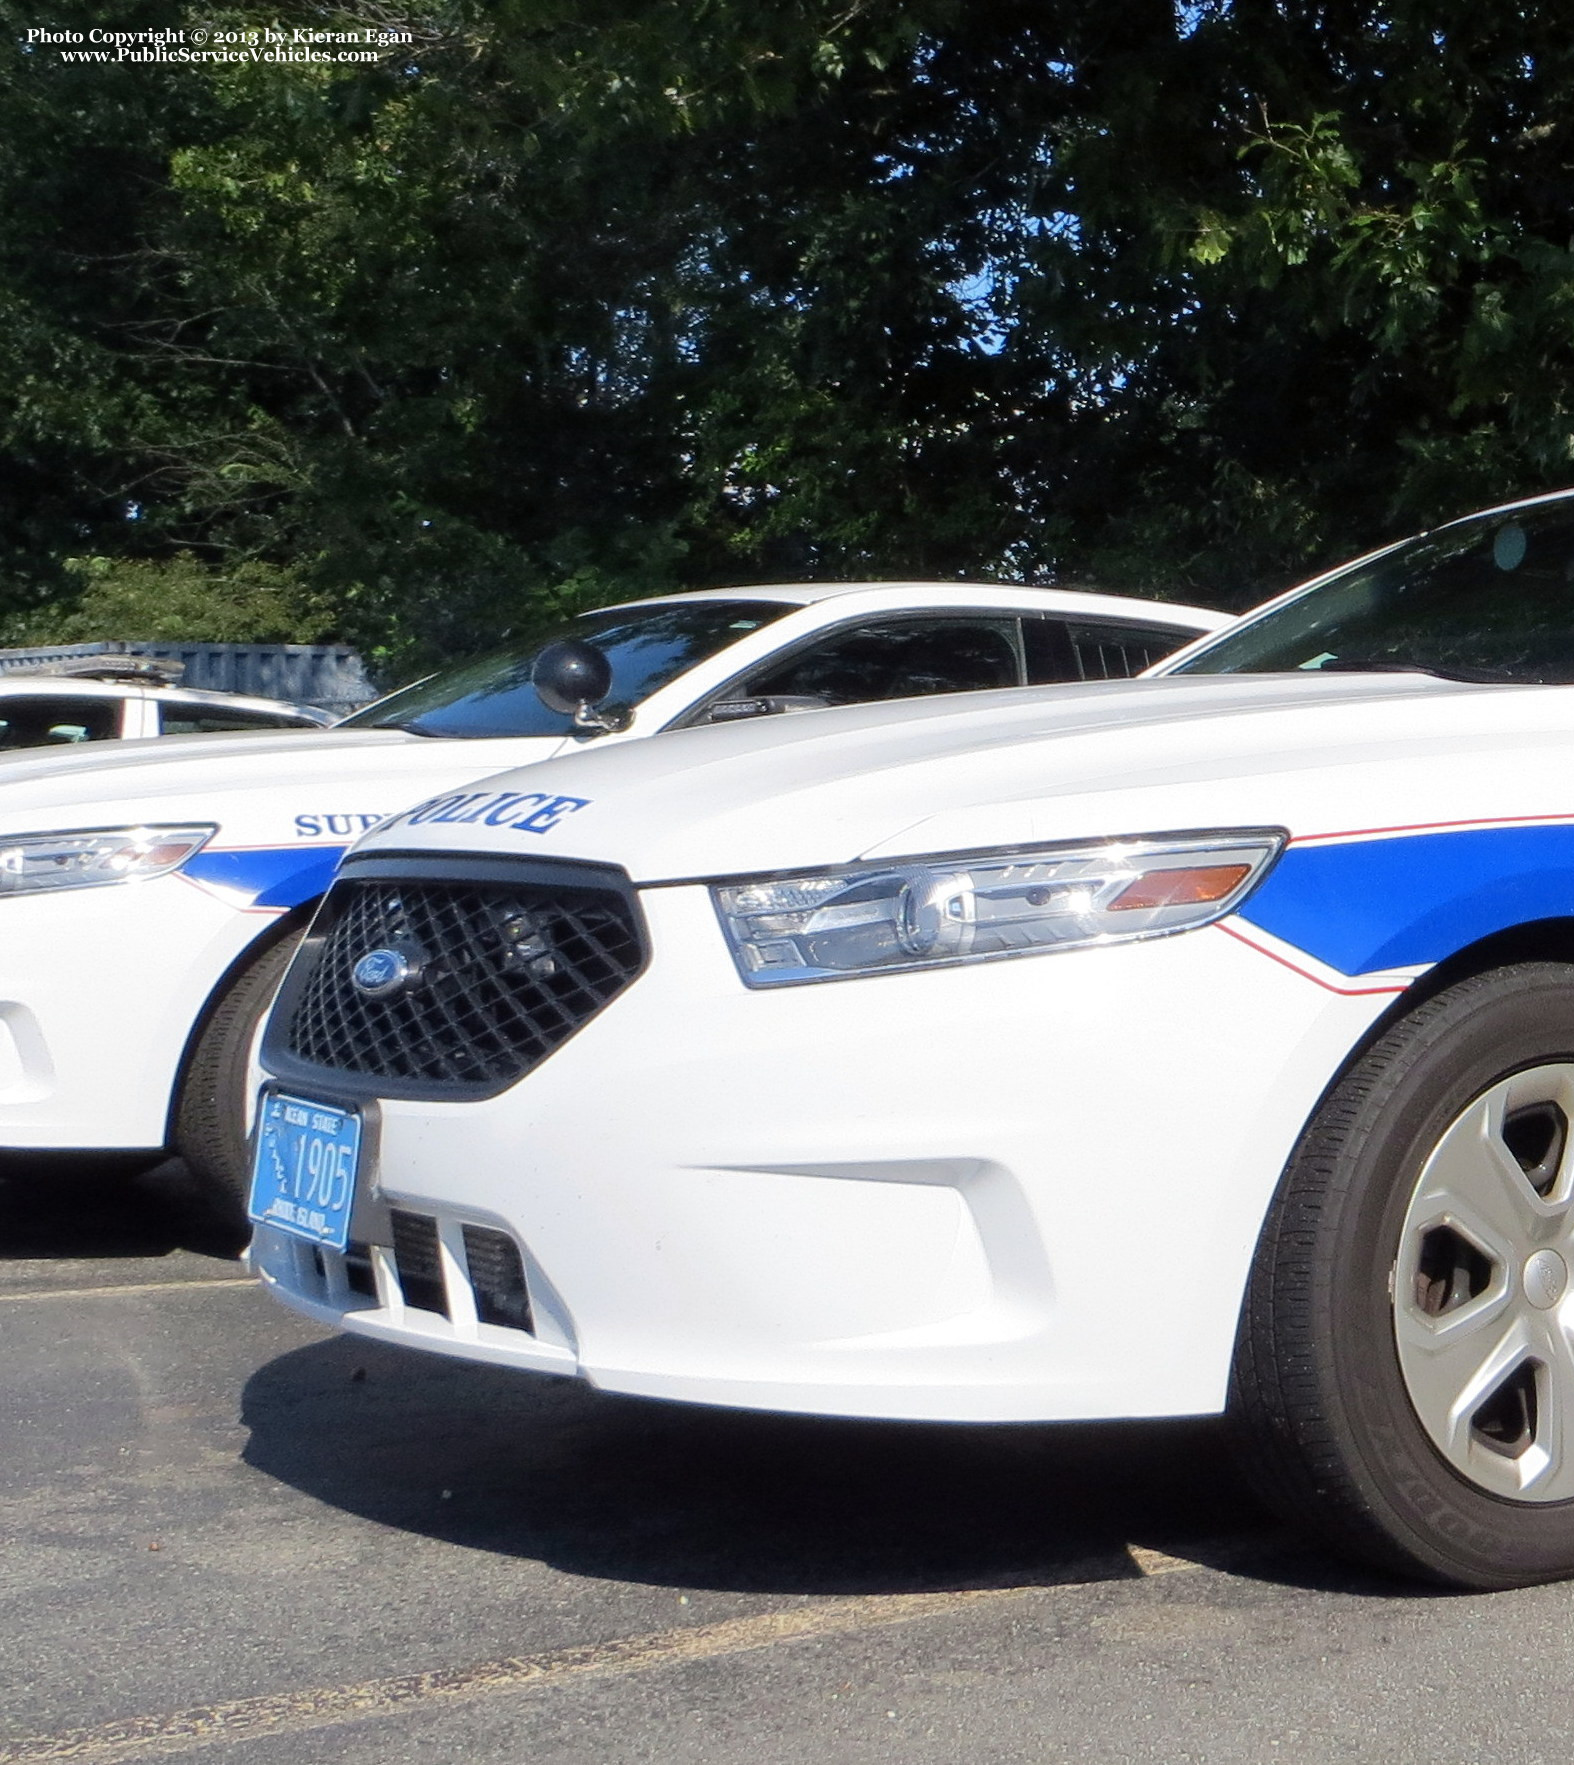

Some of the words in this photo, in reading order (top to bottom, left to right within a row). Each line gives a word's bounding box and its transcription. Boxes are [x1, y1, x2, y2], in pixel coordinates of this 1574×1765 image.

[294, 813, 395, 837] SUP
[374, 792, 595, 835] POLICE
[295, 1134, 353, 1211] 1905
